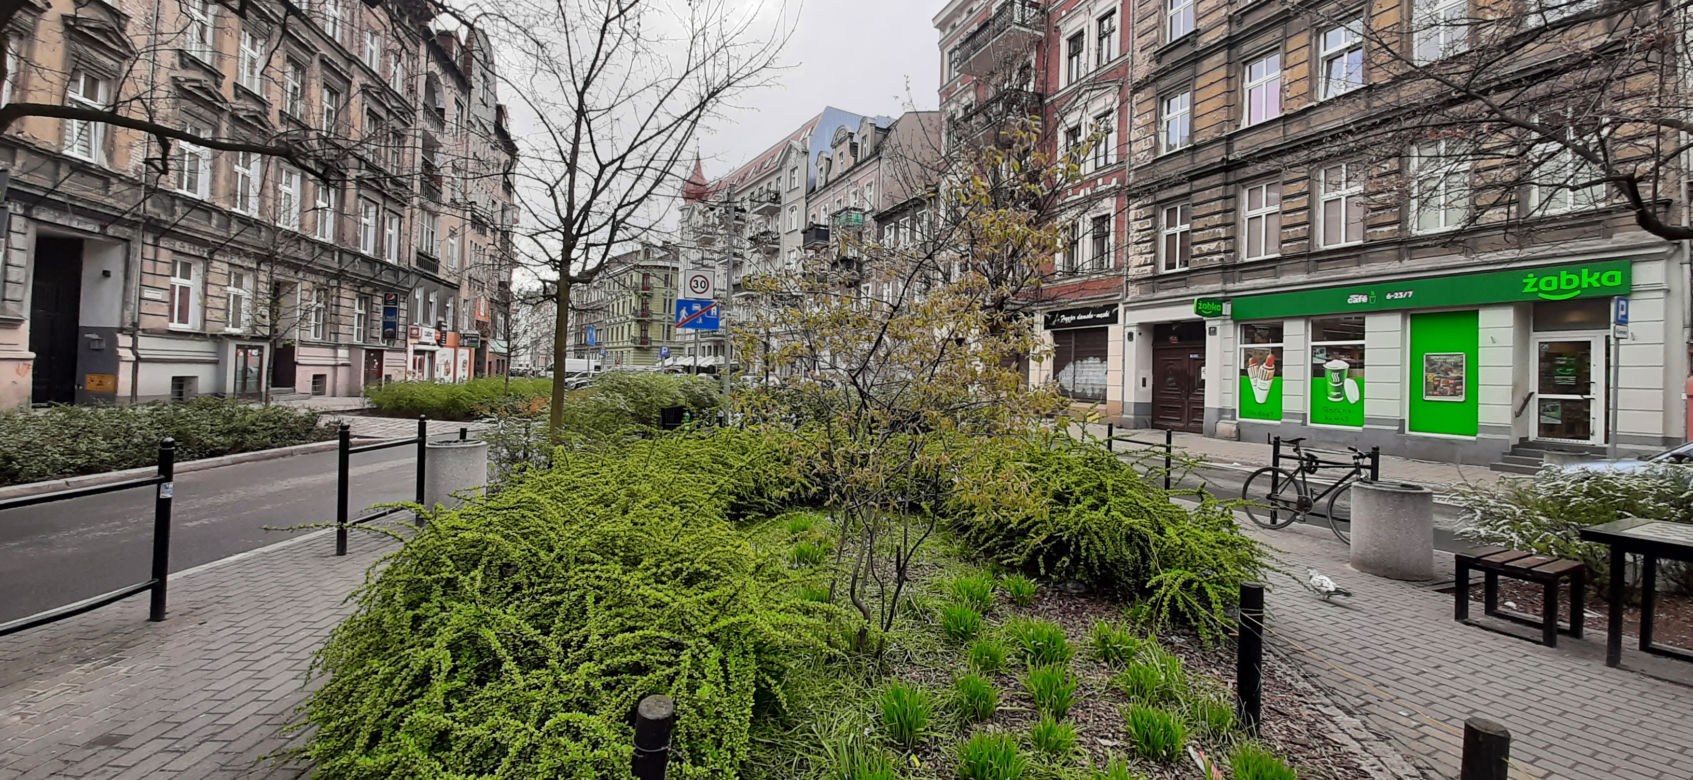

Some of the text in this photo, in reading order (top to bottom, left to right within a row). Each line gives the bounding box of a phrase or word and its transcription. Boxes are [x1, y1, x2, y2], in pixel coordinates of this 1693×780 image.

[693, 279, 706, 289] 30
[1522, 268, 1622, 293] żabka
[1386, 290, 1414, 300] 6-23/7
[1198, 300, 1222, 311] żabka
[1618, 300, 1626, 320] P
